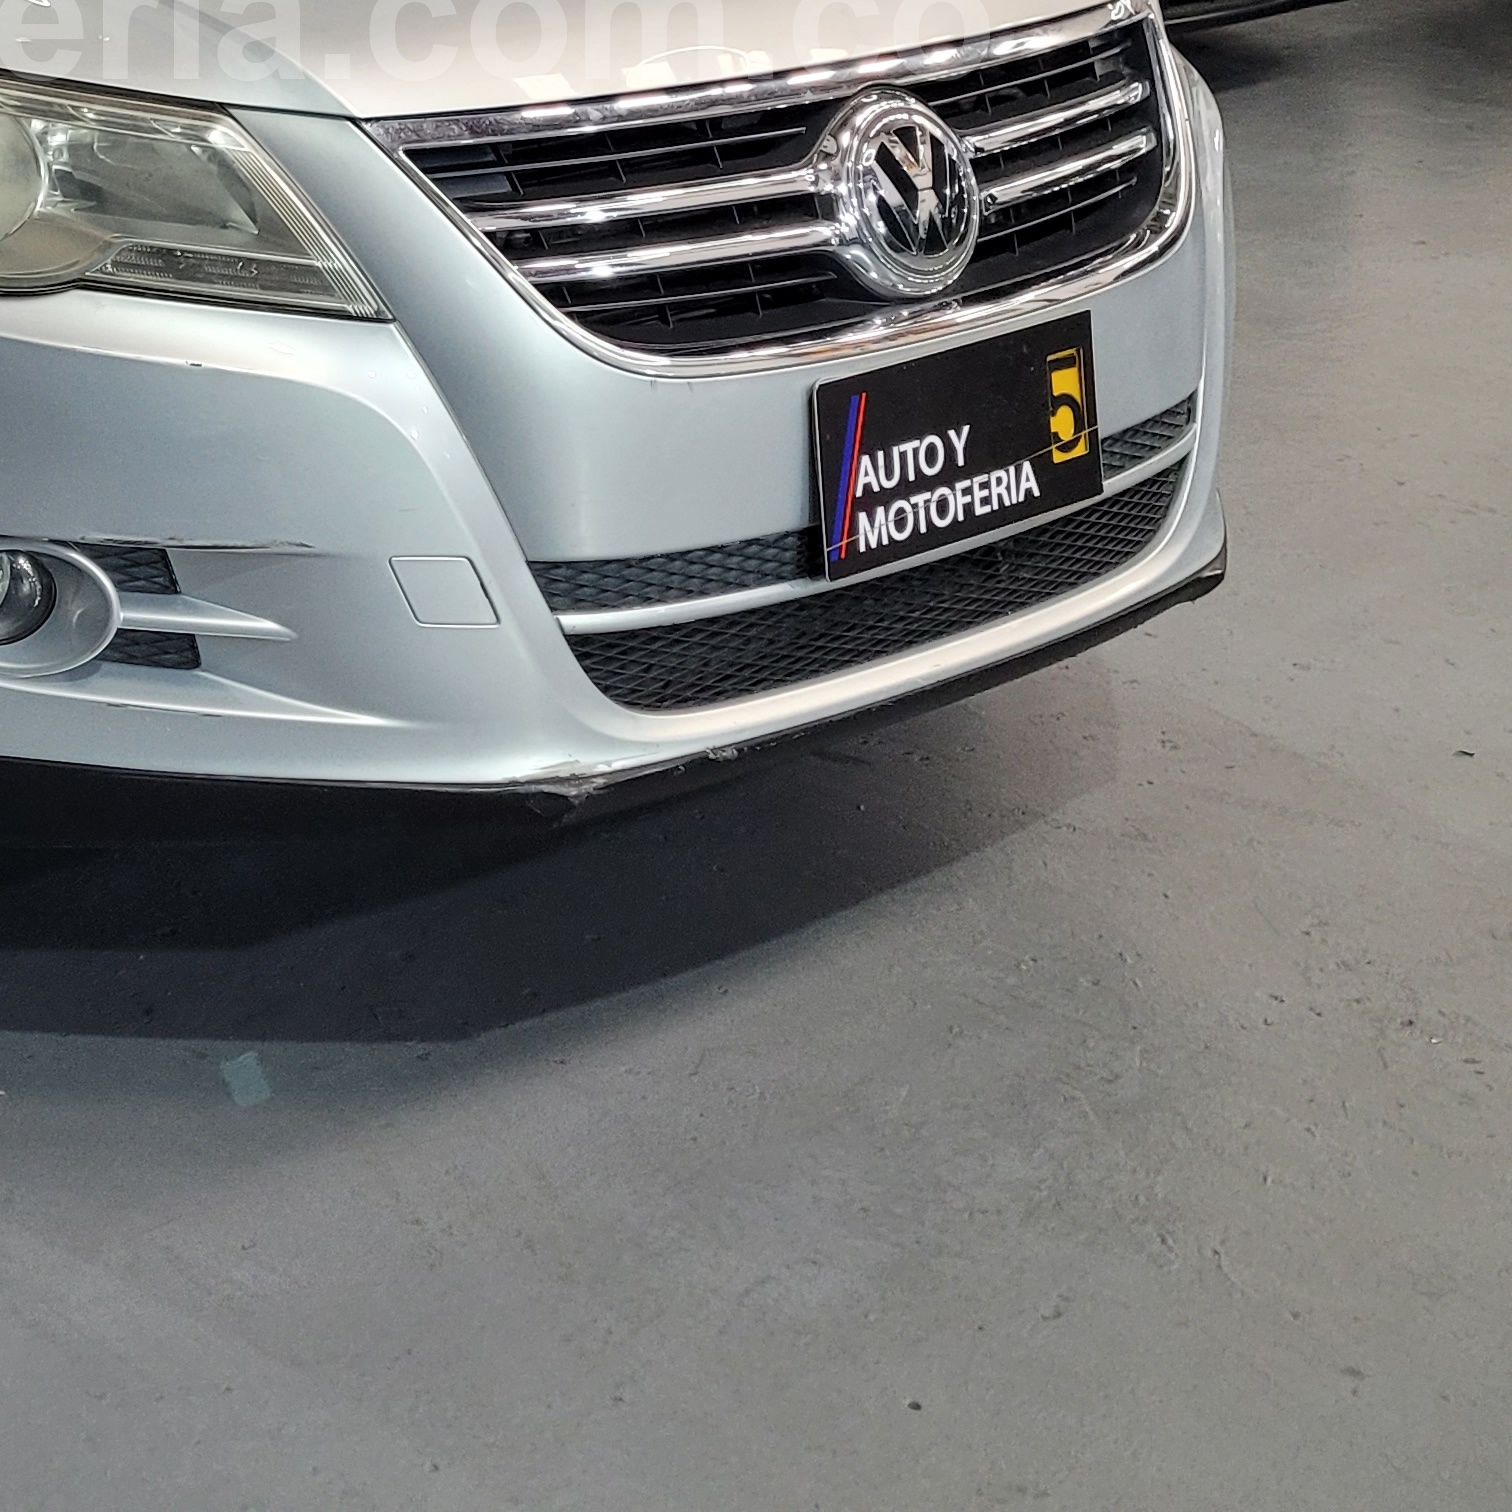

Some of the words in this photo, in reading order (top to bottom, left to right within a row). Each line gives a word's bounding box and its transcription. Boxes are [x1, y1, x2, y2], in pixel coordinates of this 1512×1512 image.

[854, 434, 946, 499] AUTO
[947, 424, 972, 467] Y
[857, 460, 1041, 553] MOTOFERIA
